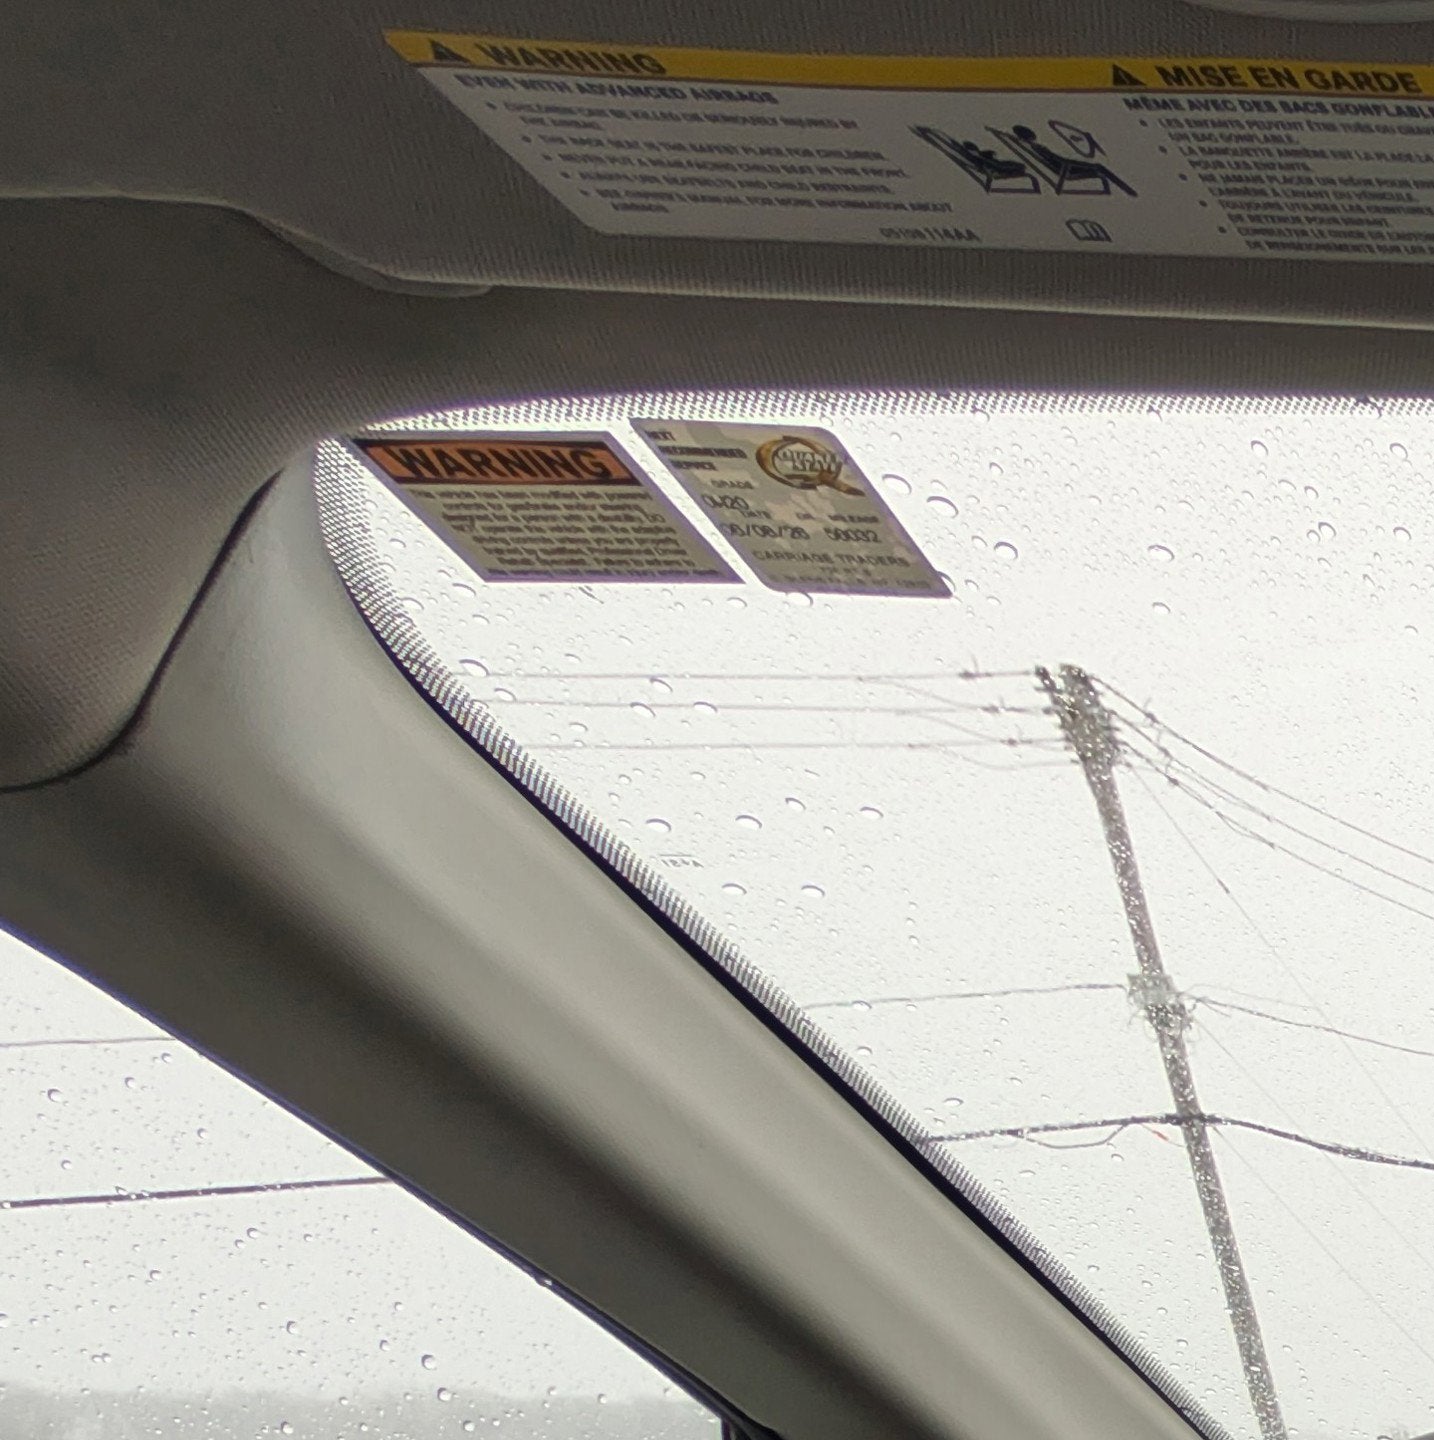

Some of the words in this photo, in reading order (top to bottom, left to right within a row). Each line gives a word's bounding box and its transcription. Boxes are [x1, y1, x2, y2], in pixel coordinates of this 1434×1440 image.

[474, 43, 667, 74] WARNING
[576, 82, 687, 100] ADVANCED
[1157, 65, 1242, 88] MISE
[1249, 67, 1300, 90] EN
[1308, 69, 1423, 94] GARDE
[1122, 94, 1185, 114] MÊME
[1187, 98, 1236, 115] AVEC
[1238, 100, 1275, 116] DES
[387, 444, 611, 480] WARNING
